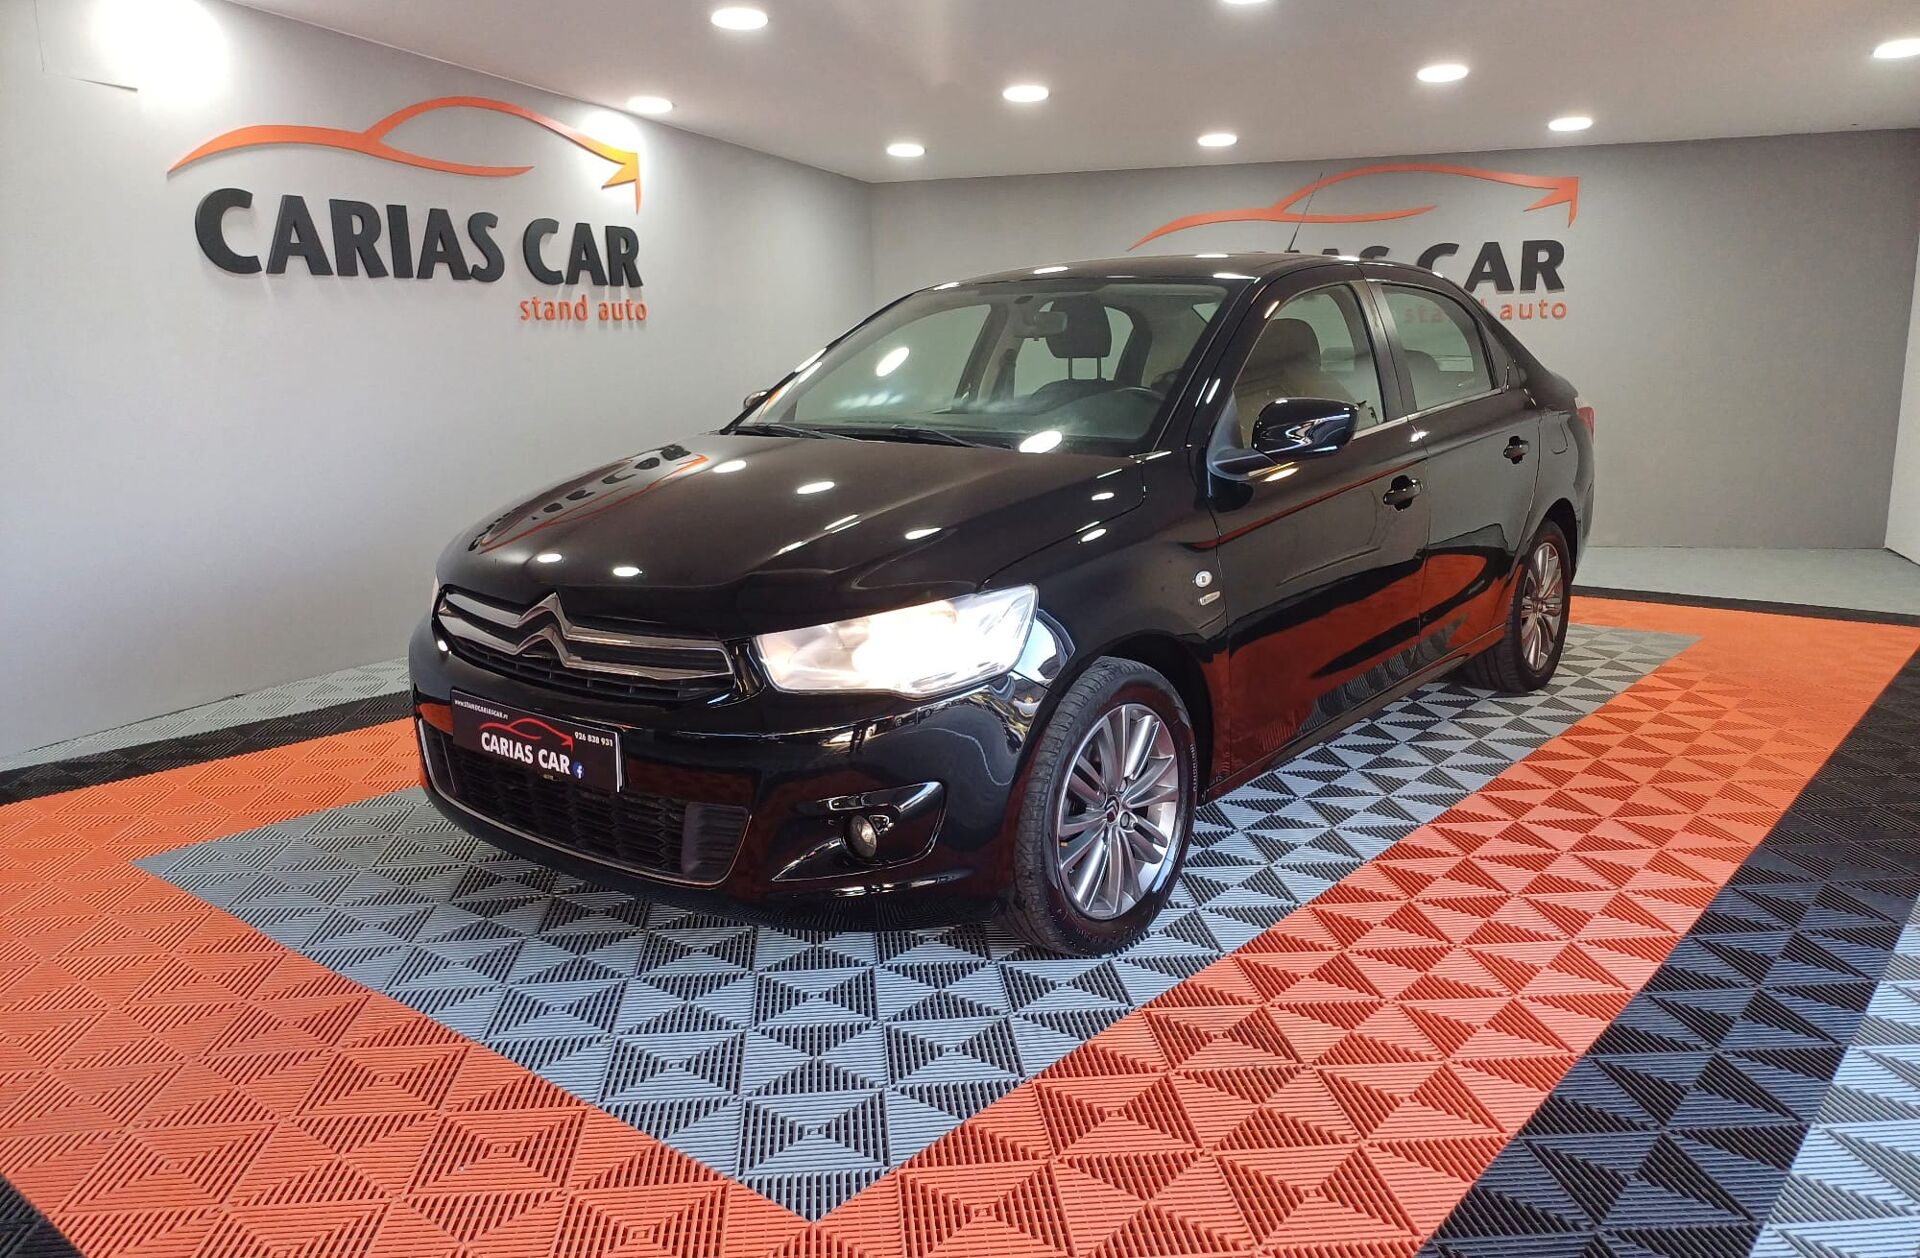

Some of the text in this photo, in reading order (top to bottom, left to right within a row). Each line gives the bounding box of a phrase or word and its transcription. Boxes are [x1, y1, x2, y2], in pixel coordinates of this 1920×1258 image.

[194, 187, 644, 288] CARIAS CAR
[519, 293, 648, 321] stand auto
[1499, 299, 1568, 321] auto
[481, 731, 571, 775] CARIAS CAR
[574, 731, 587, 741] 926
[600, 737, 613, 747] 931
